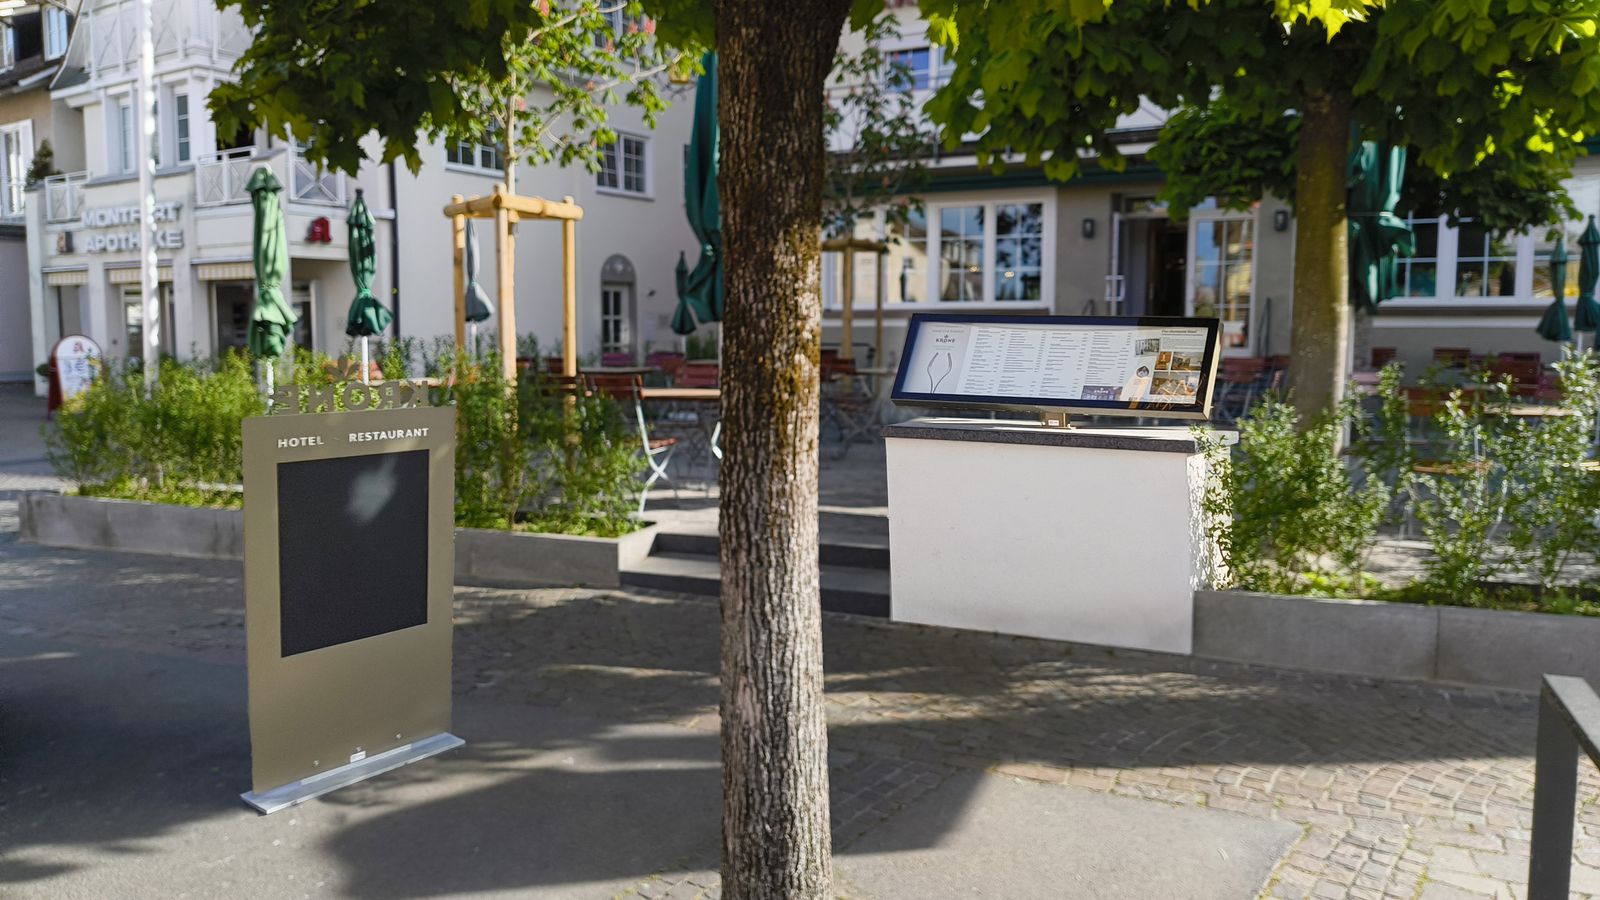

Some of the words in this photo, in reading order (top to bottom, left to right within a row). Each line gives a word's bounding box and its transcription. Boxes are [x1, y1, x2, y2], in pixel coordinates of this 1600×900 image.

[82, 203, 180, 227] MONTFRT
[81, 230, 183, 252] APOTHKE
[277, 436, 324, 448] HOTEL
[348, 428, 429, 442] RESTAURANT
